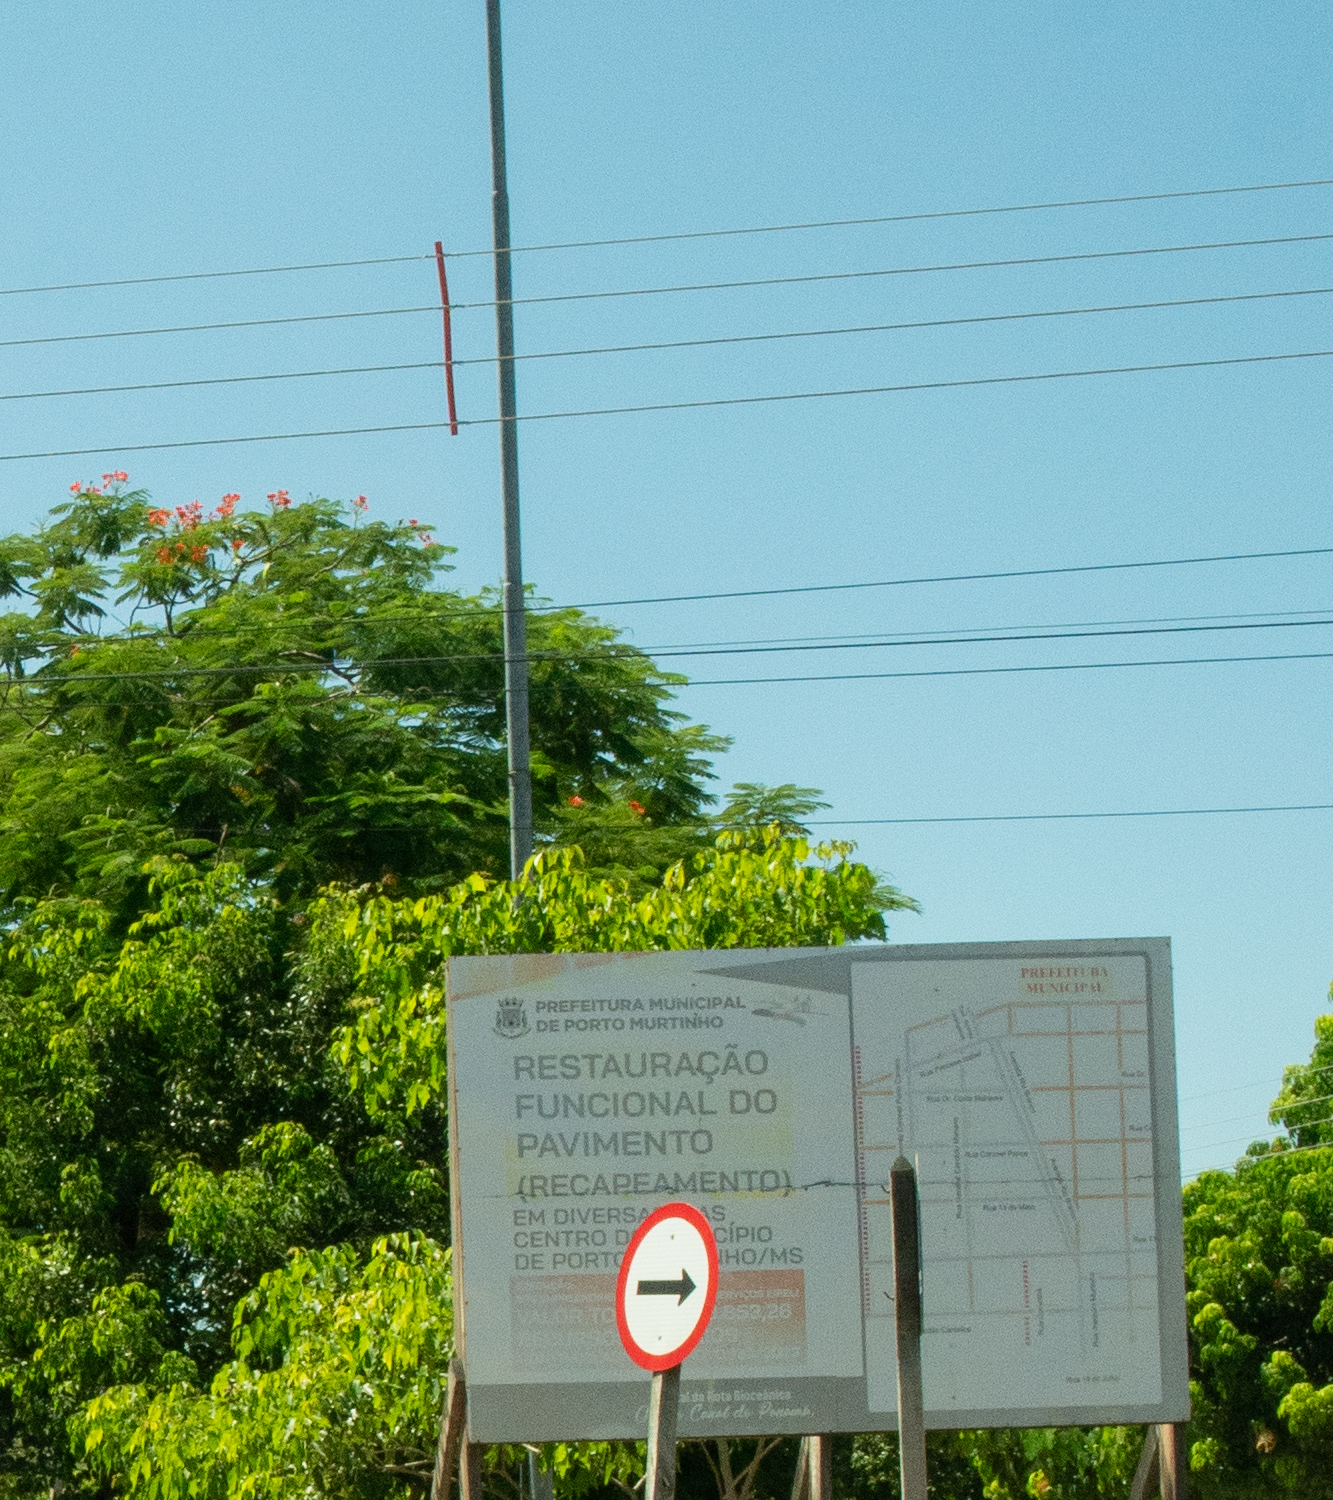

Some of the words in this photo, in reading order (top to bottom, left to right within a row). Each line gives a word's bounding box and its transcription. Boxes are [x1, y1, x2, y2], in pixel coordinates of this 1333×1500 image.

[535, 998, 644, 1014] PREFEITURA
[649, 996, 746, 1011] MUNICIPAL
[536, 1018, 560, 1033] DE
[564, 1017, 626, 1032] PORTO
[629, 1014, 724, 1031] MURTINHO
[513, 1043, 769, 1085] RESTAURAÇÃO
[516, 1089, 718, 1119] FUNCIONAL
[729, 1088, 778, 1115] DO
[517, 1129, 714, 1158] PAVIMENTO
[518, 1168, 792, 1203] (RECAPEAMENTO)
[513, 1208, 546, 1226] EM
[553, 1206, 651, 1225] DIVERSA
[513, 1229, 607, 1248] CENTRO
[615, 1229, 631, 1247] D
[515, 1253, 545, 1270] DE
